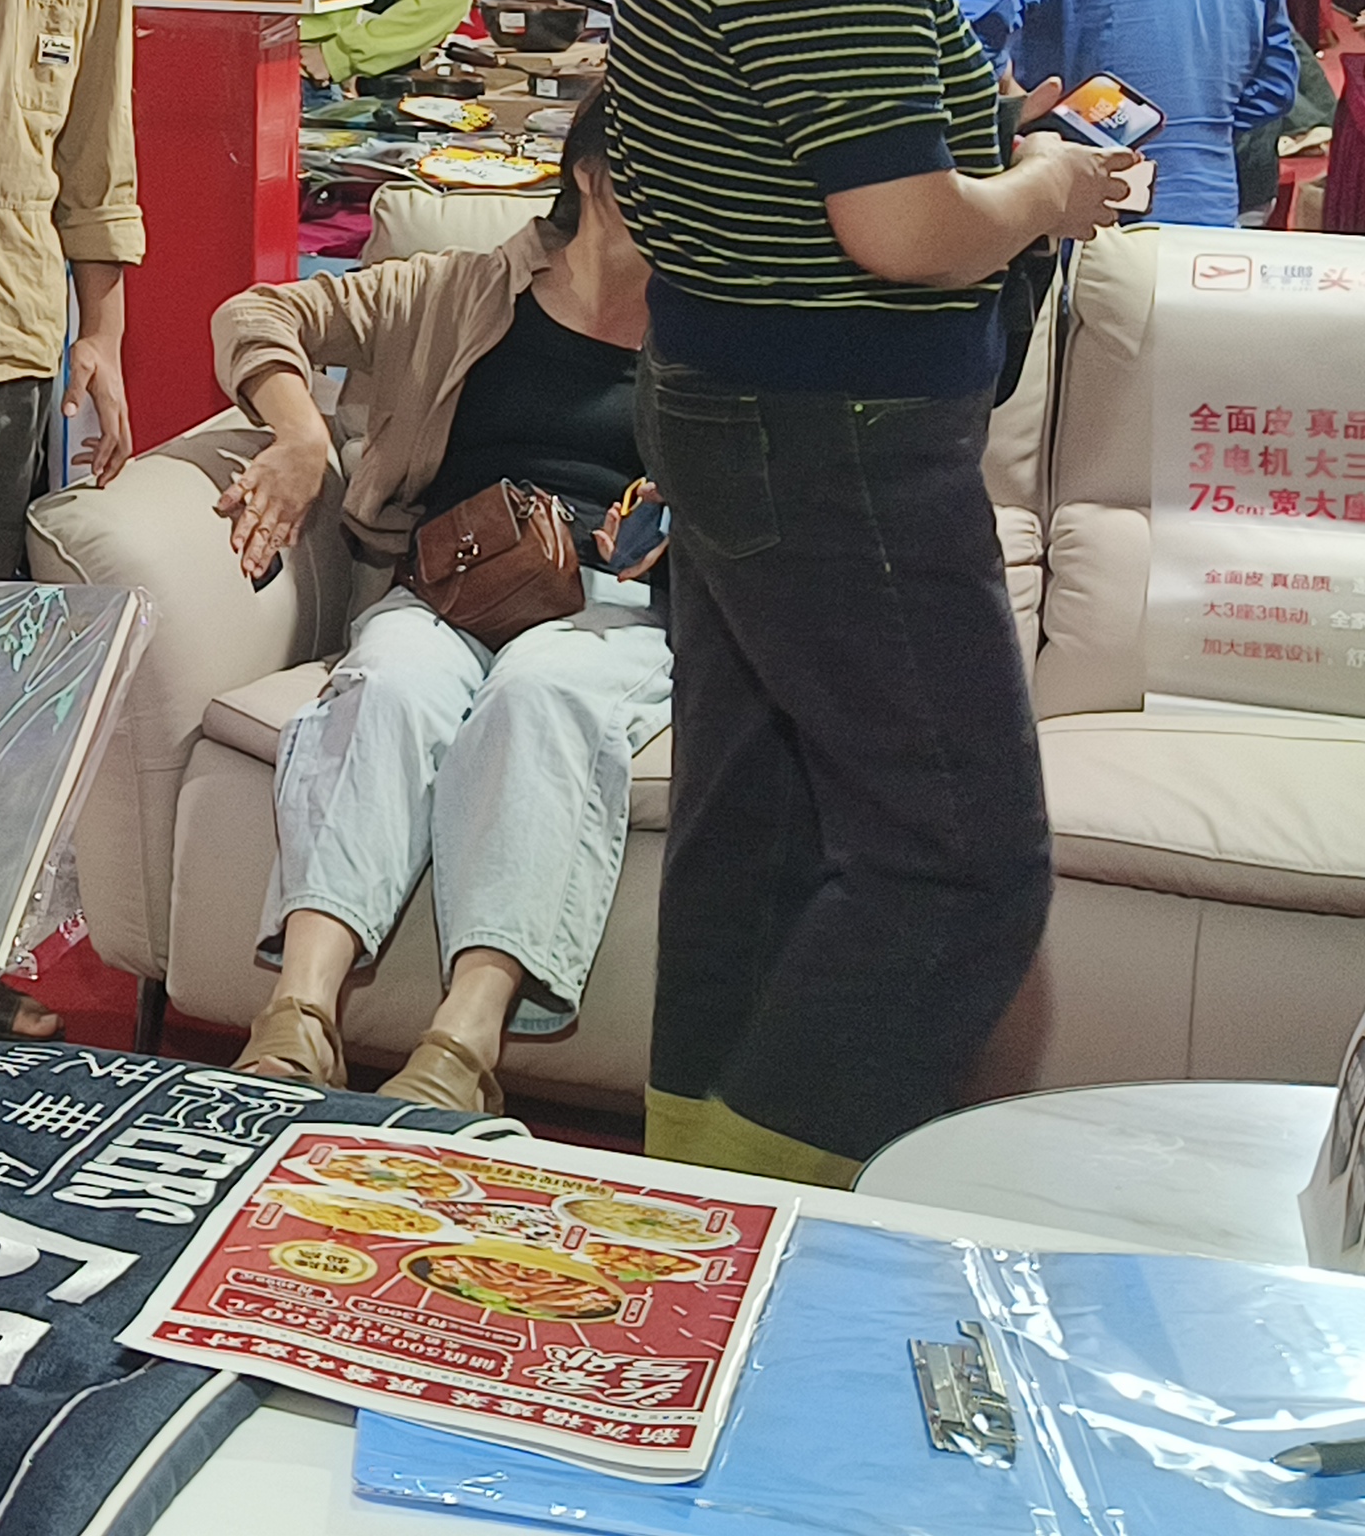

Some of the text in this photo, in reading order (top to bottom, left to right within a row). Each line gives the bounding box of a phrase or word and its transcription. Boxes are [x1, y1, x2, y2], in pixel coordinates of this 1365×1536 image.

[1189, 403, 1293, 437] 全面皮
[1189, 442, 1293, 477] 3电机
[1204, 569, 1264, 588] 全面皮
[1203, 602, 1309, 626] 大3座3电动
[1202, 638, 1325, 664] 加大座宽设计
[166, 1327, 682, 1447] 新派福建菜 跟着吃就对了
